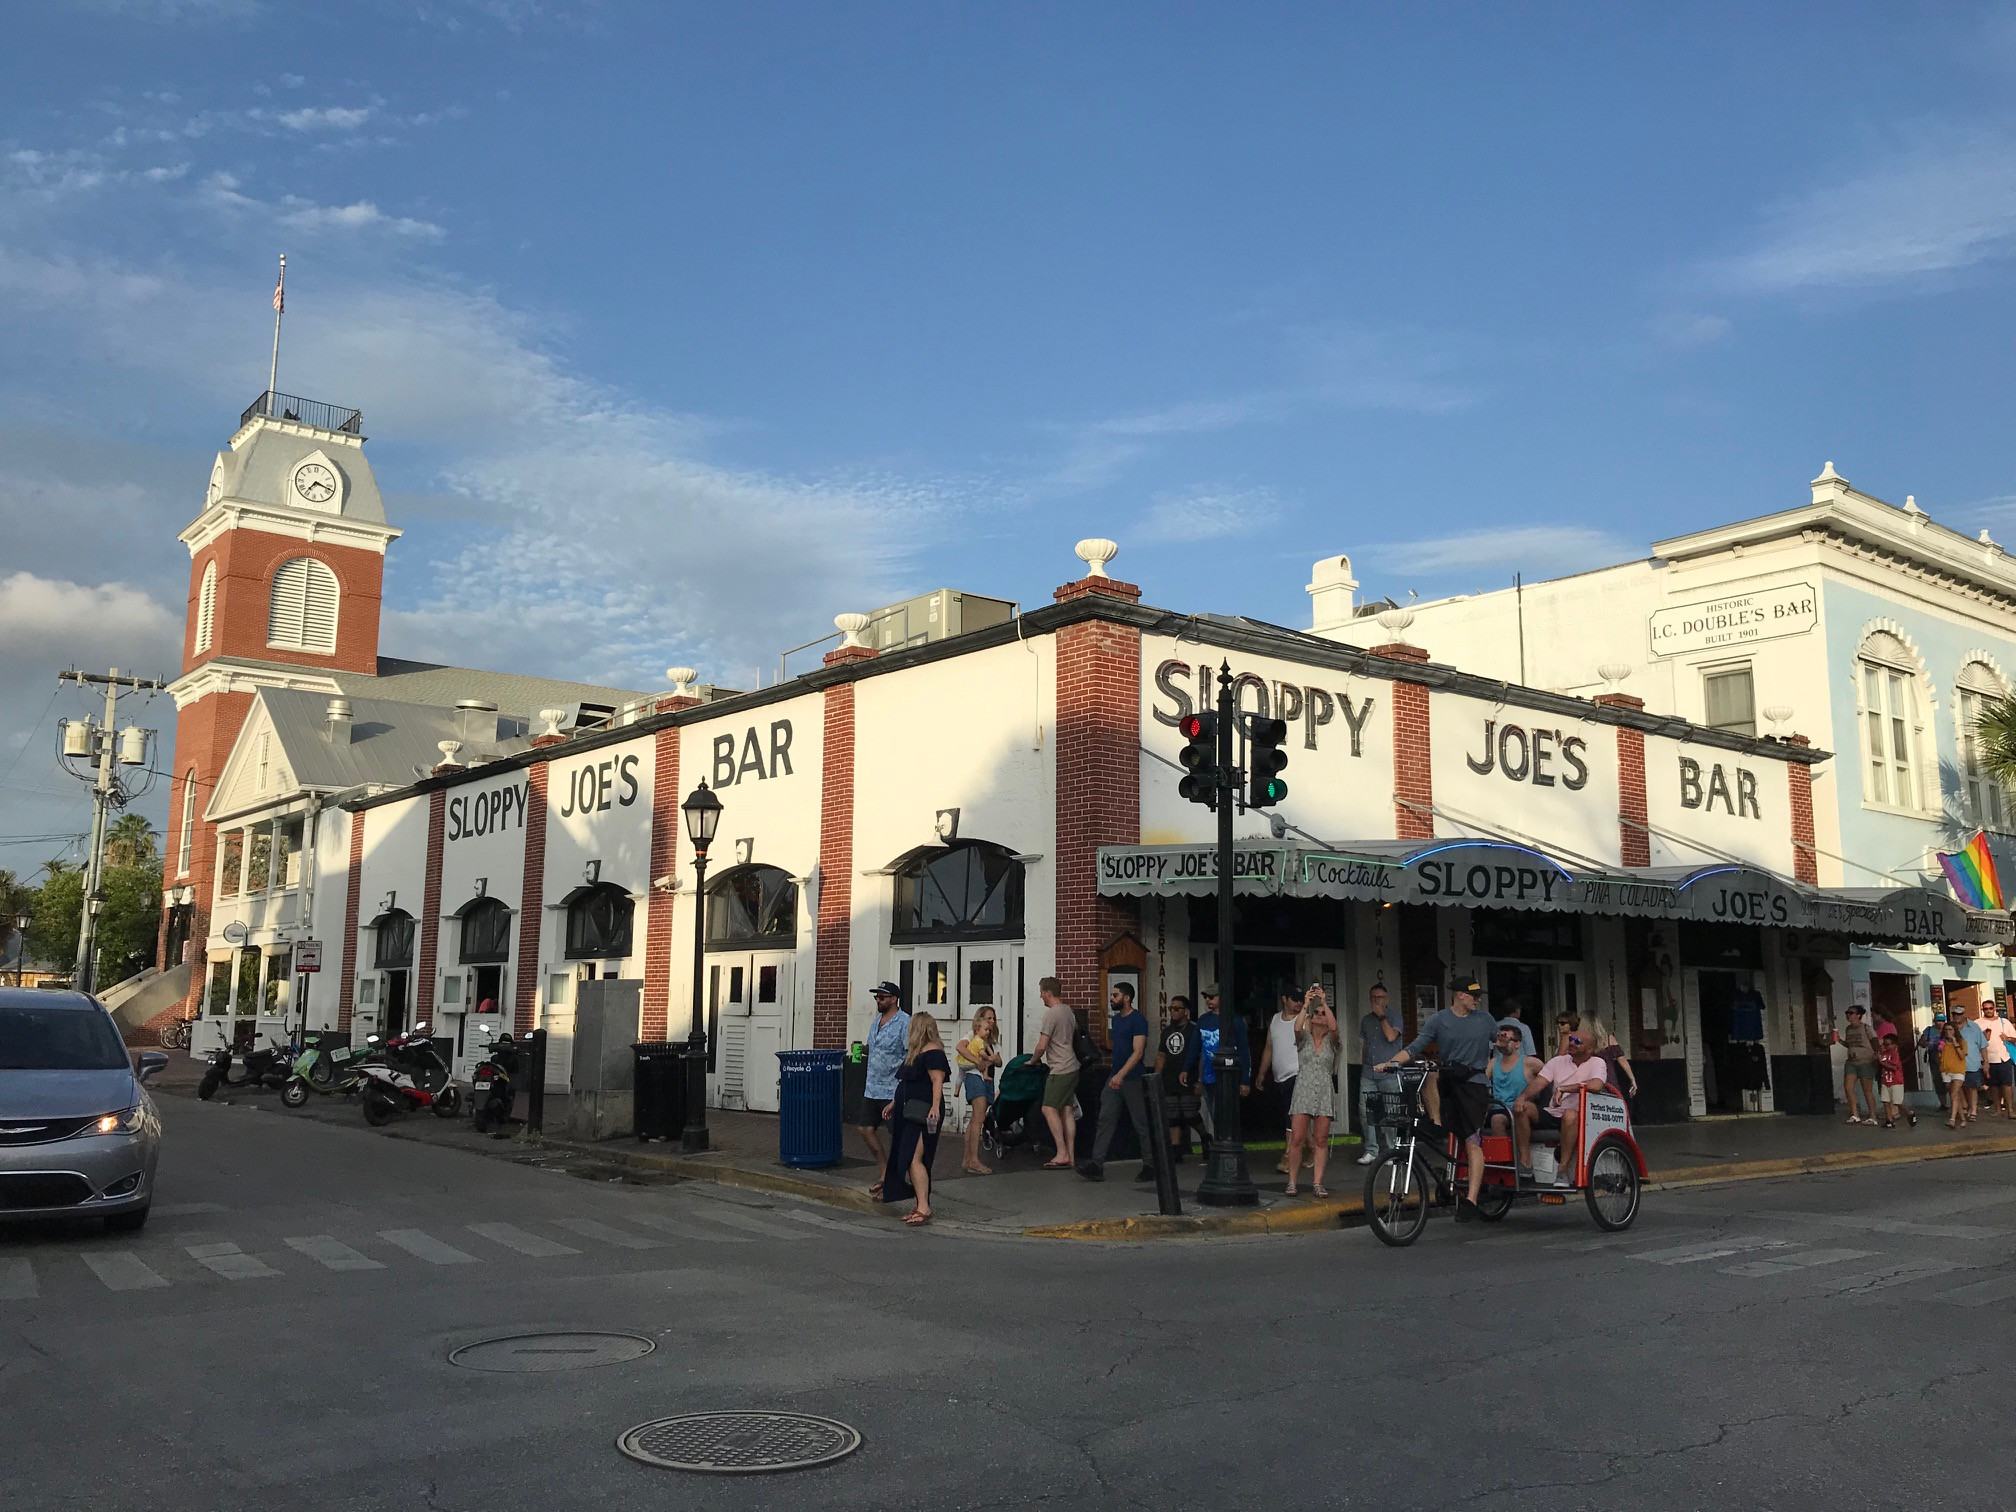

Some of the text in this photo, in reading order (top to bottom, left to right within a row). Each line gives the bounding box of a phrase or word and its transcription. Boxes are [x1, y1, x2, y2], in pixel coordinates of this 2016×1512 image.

[1652, 599, 1813, 640] I.C. DOUBLE'S BAR
[1706, 597, 1754, 614] HISTORIC
[1705, 628, 1759, 645] BUILT 1901
[448, 718, 794, 842] SLOPPY JOE'S BAR
[1466, 718, 1589, 791] JOE'S
[1678, 755, 1761, 820] BAR
[1104, 854, 1168, 879] SLOPPY
[1233, 852, 1275, 876] BAR
[1317, 861, 1395, 889] Cocktails
[1417, 861, 1560, 902] SLOPPY
[1712, 888, 1788, 923] JOE'S
[1904, 907, 1946, 937] BAR
